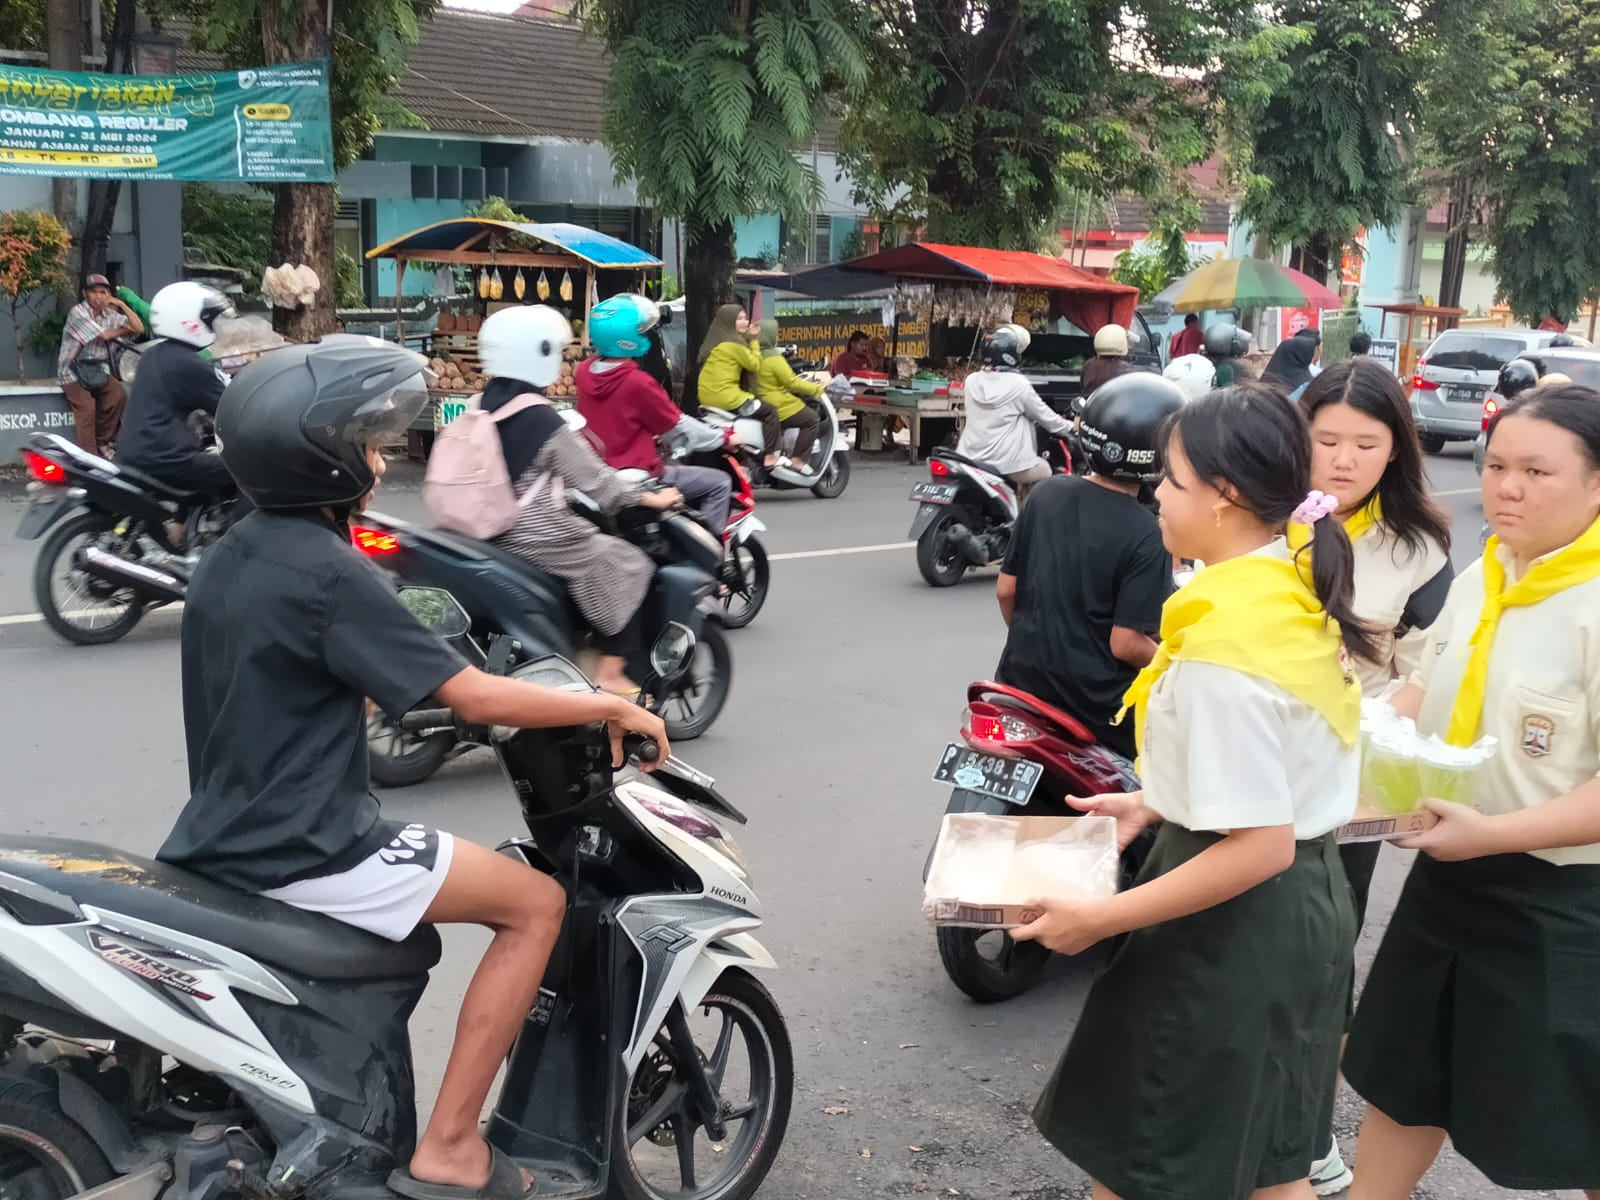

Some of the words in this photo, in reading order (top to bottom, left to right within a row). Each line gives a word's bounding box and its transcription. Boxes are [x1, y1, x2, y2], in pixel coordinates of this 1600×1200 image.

[98, 116, 188, 132] REGULER
[3, 126, 64, 139] JANUARI
[80, 132, 96, 141] 31
[100, 133, 123, 141] MEI
[126, 133, 157, 143] 2024
[40, 141, 89, 152] AJARAN
[38, 153, 57, 161] TK
[778, 326, 831, 342] EMERINTAH
[898, 321, 928, 336] EMBER
[1126, 448, 1156, 465] 1955
[943, 746, 957, 764] P
[1011, 763, 1035, 785] ER
[710, 886, 747, 904] HONDA
